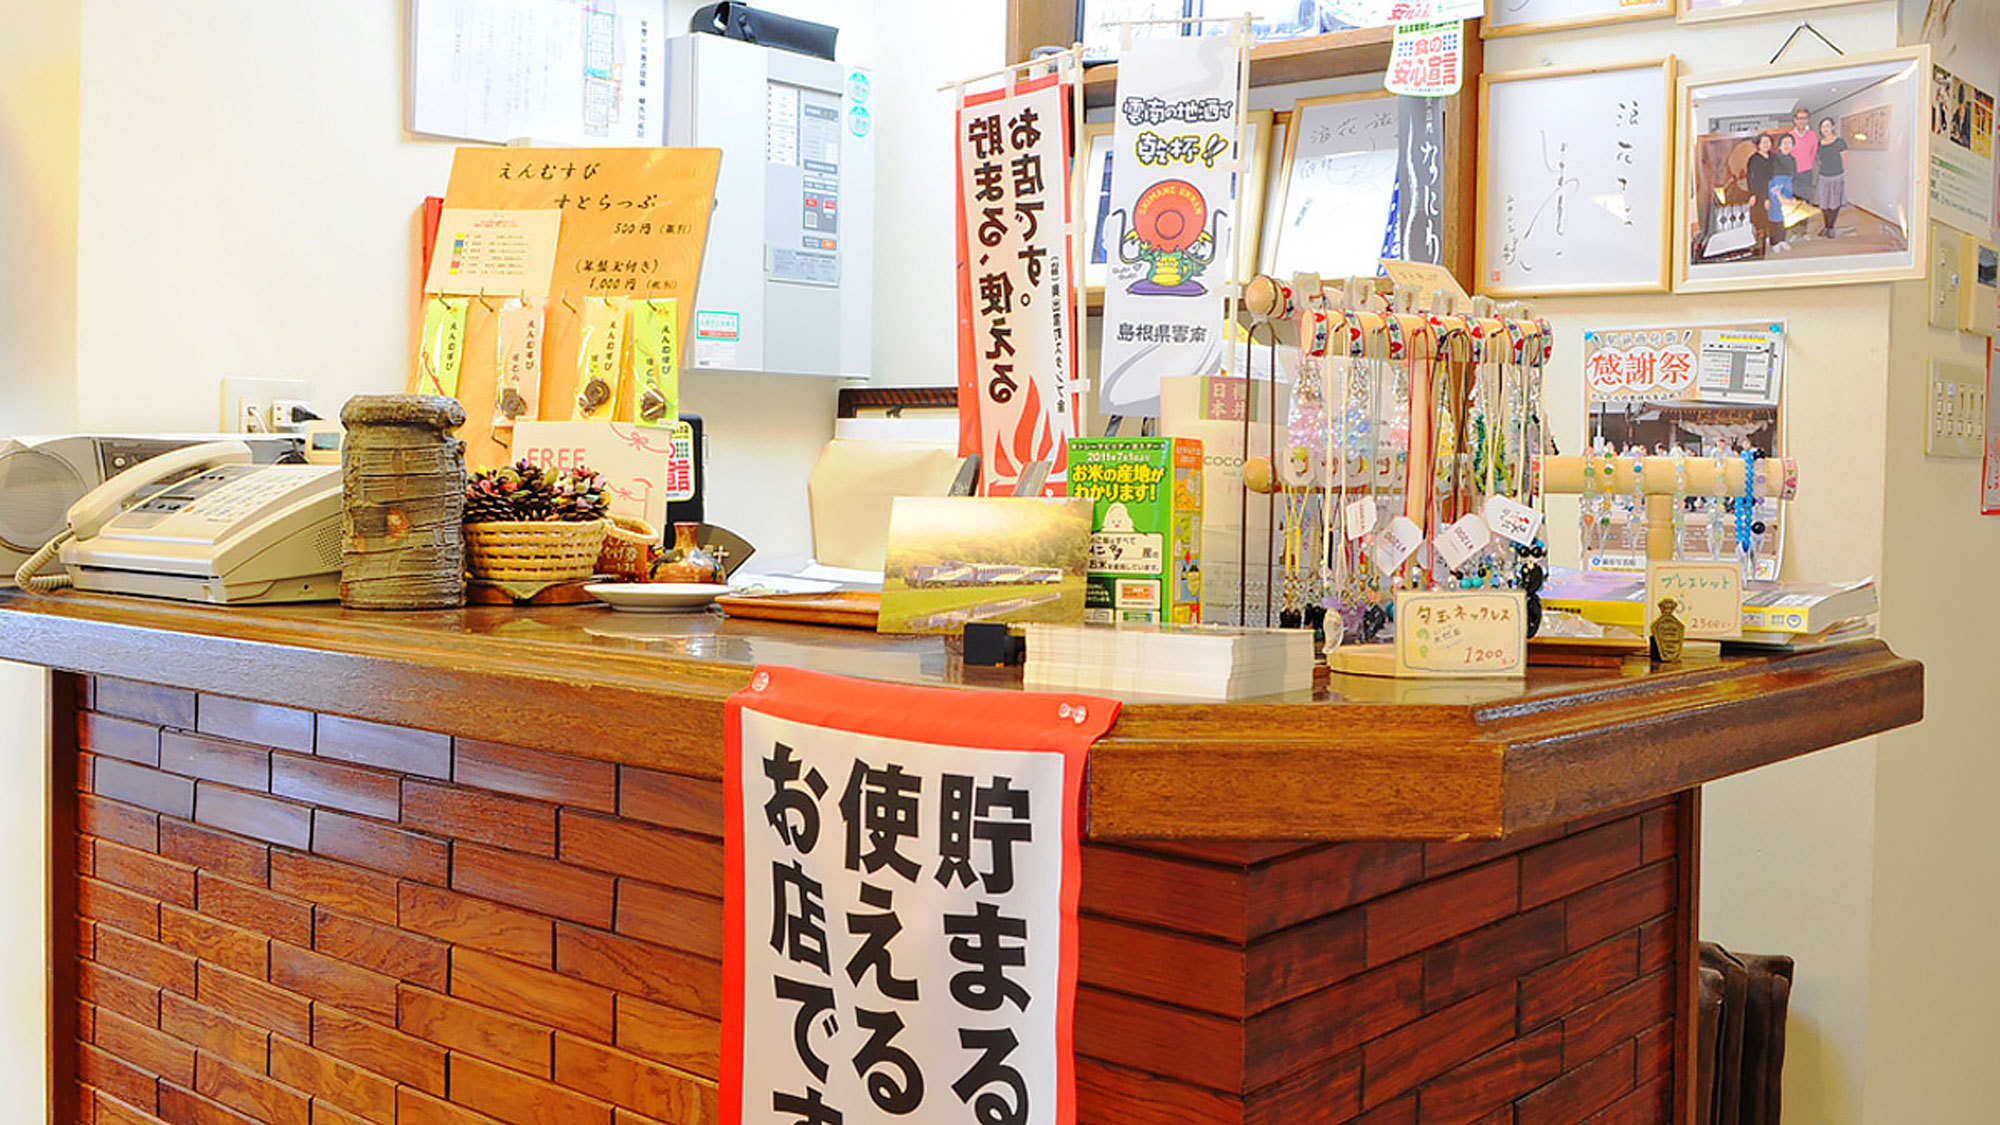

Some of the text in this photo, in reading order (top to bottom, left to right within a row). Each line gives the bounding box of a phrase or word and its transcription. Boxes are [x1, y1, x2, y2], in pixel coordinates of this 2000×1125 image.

[1392, 53, 1457, 86] 安心宣言
[1123, 97, 1234, 125] 雲南の地酒で
[499, 162, 600, 180] えんむすび
[614, 222, 651, 234] 500円
[445, 321, 458, 371] えんむすび
[525, 320, 536, 370] えんむすび
[604, 321, 616, 371] えんむすび
[1117, 322, 1207, 343] 島根県雲南
[661, 325, 672, 375] えんむすび
[1586, 351, 1691, 386] 感謝祭
[1072, 462, 1166, 483] お米の産地が
[1074, 483, 1157, 501] わかります!
[1661, 575, 1730, 590] ブレスレット
[839, 758, 925, 1116] 使える
[934, 773, 1033, 1125] 貯まる
